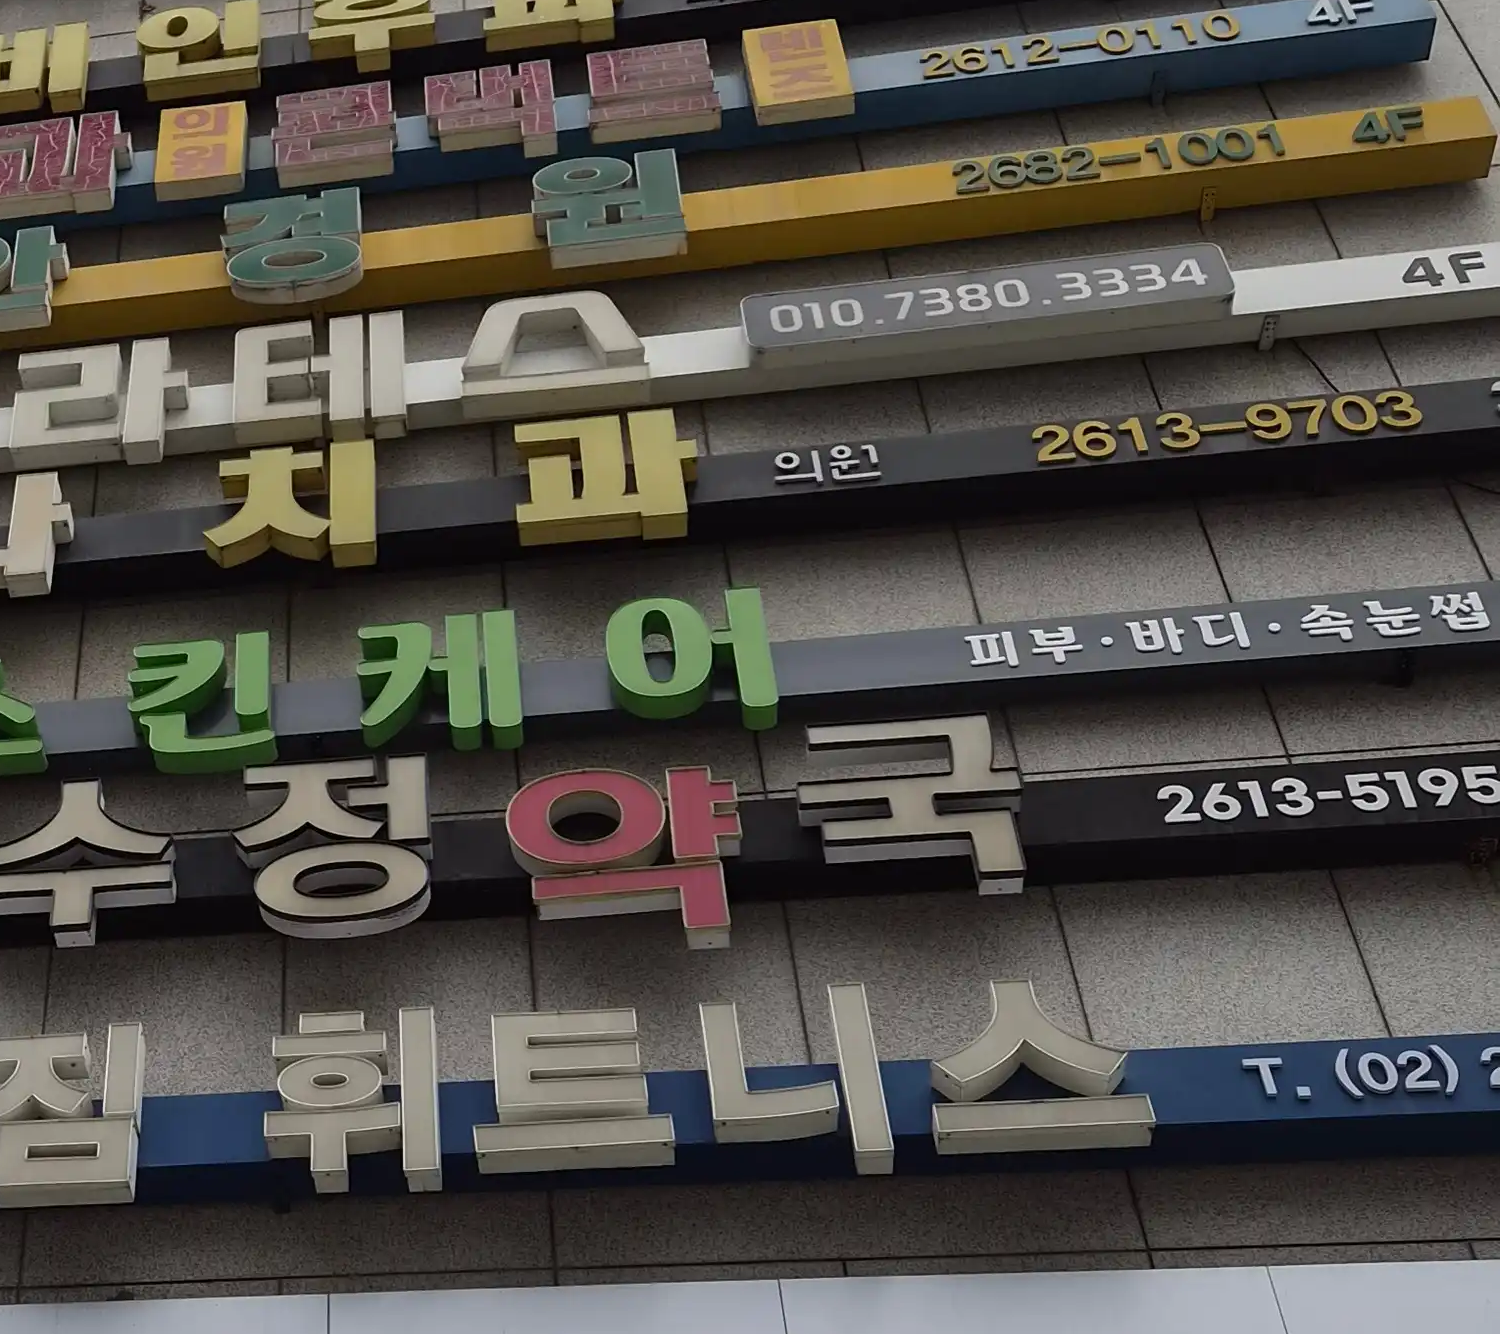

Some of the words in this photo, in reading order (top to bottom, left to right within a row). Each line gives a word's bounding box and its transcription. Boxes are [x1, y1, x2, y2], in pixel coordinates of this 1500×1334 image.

[919, 11, 1242, 79] 2612-0110
[952, 124, 1287, 196] 2682-1001
[1352, 106, 1426, 146] 4F
[769, 258, 1208, 335] 010.7380.3334
[1401, 251, 1486, 288] 4F
[774, 443, 882, 485] 의원
[1031, 390, 1424, 466] 2613-9703
[1156, 764, 1500, 824] 2613-5195
[1335, 1044, 1460, 1100] (02)
